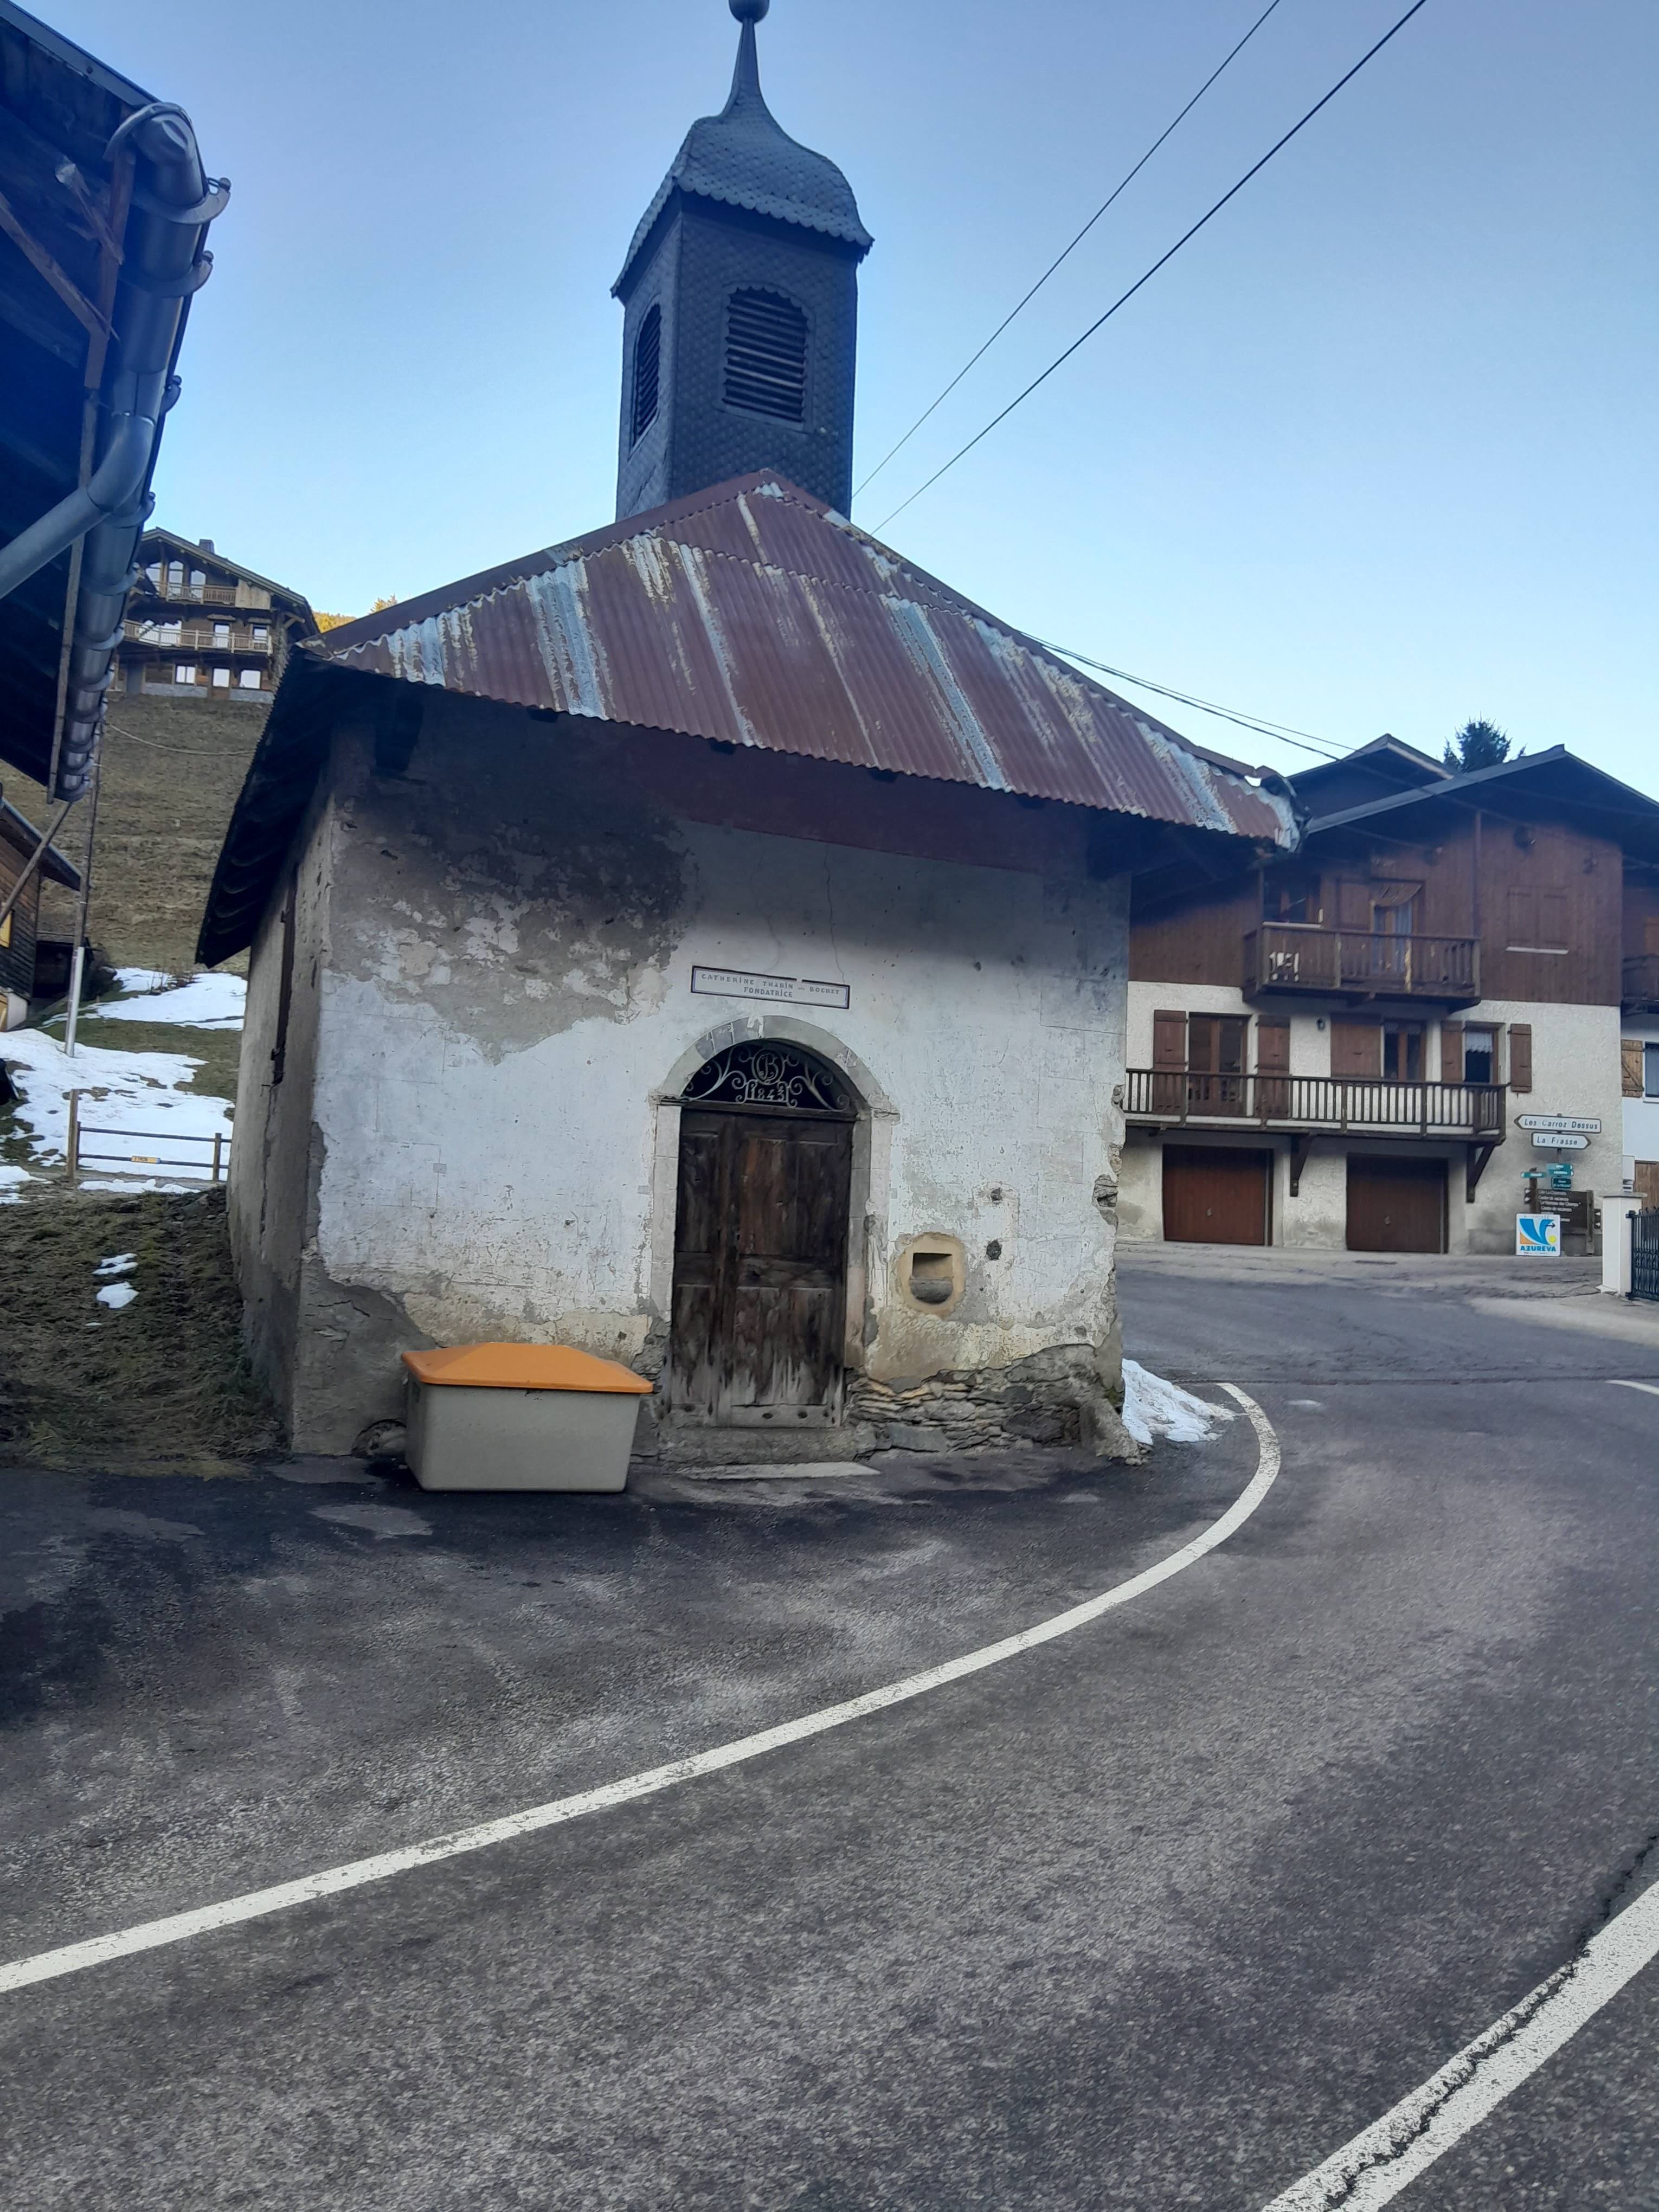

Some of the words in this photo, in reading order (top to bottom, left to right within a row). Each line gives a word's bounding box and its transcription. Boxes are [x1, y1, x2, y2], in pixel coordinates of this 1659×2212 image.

[701, 974, 755, 985] CATHERINE
[762, 980, 793, 989] THARIN
[809, 987, 840, 995] BOCHET
[744, 986, 793, 998] FONDATRICE
[750, 1083, 785, 1102] 1843
[1524, 1118, 1537, 1127] Les
[1542, 1120, 1567, 1128] Carroz
[1571, 1121, 1598, 1129] Dessus
[1536, 1136, 1546, 1144] La
[1551, 1136, 1578, 1145] Frasse
